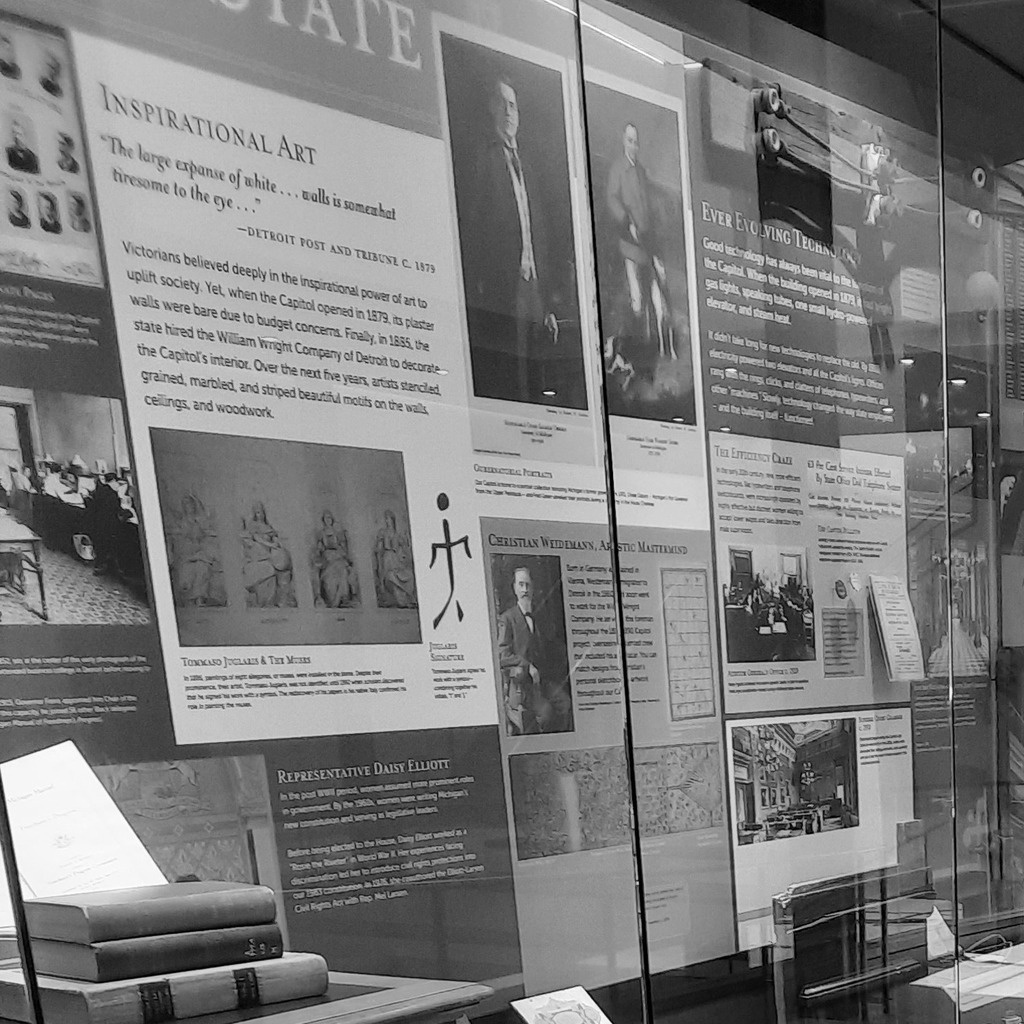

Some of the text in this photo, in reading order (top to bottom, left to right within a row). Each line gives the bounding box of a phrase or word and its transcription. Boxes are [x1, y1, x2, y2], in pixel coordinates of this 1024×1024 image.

[98, 81, 317, 165] INSPIRATIONAL ART
[112, 167, 233, 212] tiresome to the eye
[138, 143, 171, 173] large
[176, 160, 225, 181] expanse
[229, 168, 242, 190] of
[244, 172, 277, 194] white
[302, 188, 331, 206] walls
[333, 193, 341, 208] is
[343, 202, 397, 221] somewhat
[701, 201, 733, 228] EVER
[735, 211, 791, 245] EVOLVING
[122, 240, 428, 309] Victorians believed deeply in the inspirational power of art to
[300, 237, 326, 252] POST
[330, 245, 352, 257] AND
[354, 248, 399, 267] TRIBUNE
[415, 261, 436, 274] 1879
[127, 269, 435, 332] uplift society. Yet, when the Capitol opened in 1879, its plaster
[129, 294, 160, 309] walls
[163, 301, 191, 314] were
[193, 303, 218, 319] bare
[220, 308, 240, 322] due
[243, 312, 254, 325] to
[257, 313, 293, 332] budget
[295, 321, 343, 338] concerns.
[345, 327, 377, 345] Finally,
[378, 333, 388, 345] in
[415, 339, 430, 352] the
[134, 319, 162, 334] state
[165, 322, 194, 339] hired
[196, 327, 215, 342] the
[216, 330, 257, 348] William
[258, 336, 293, 354] Wright
[295, 342, 341, 363] Company
[344, 351, 354, 362] of
[356, 351, 388, 367] Detroit
[390, 357, 400, 369] to
[137, 343, 157, 357] the
[210, 352, 251, 370] interior.
[253, 359, 279, 374] Over
[282, 363, 298, 376] the
[300, 368, 321, 380] next
[323, 368, 341, 382] five
[343, 374, 369, 387] years,
[371, 377, 399, 390] artists
[401, 381, 442, 397] stenciled,
[141, 369, 187, 387] grained,
[190, 374, 237, 393] marbled,
[239, 381, 259, 394] and
[262, 383, 296, 399] striped
[298, 388, 341, 404] beautiful
[343, 395, 373, 408] motifs
[374, 400, 387, 411] on
[388, 400, 403, 412] the
[144, 394, 274, 419] ceilings, and woodwork.
[488, 533, 538, 548] CHRISTIAN
[600, 539, 635, 552] ARSTIC
[277, 759, 450, 784] REPRESENTATIVE DAISY ELLIOTT
